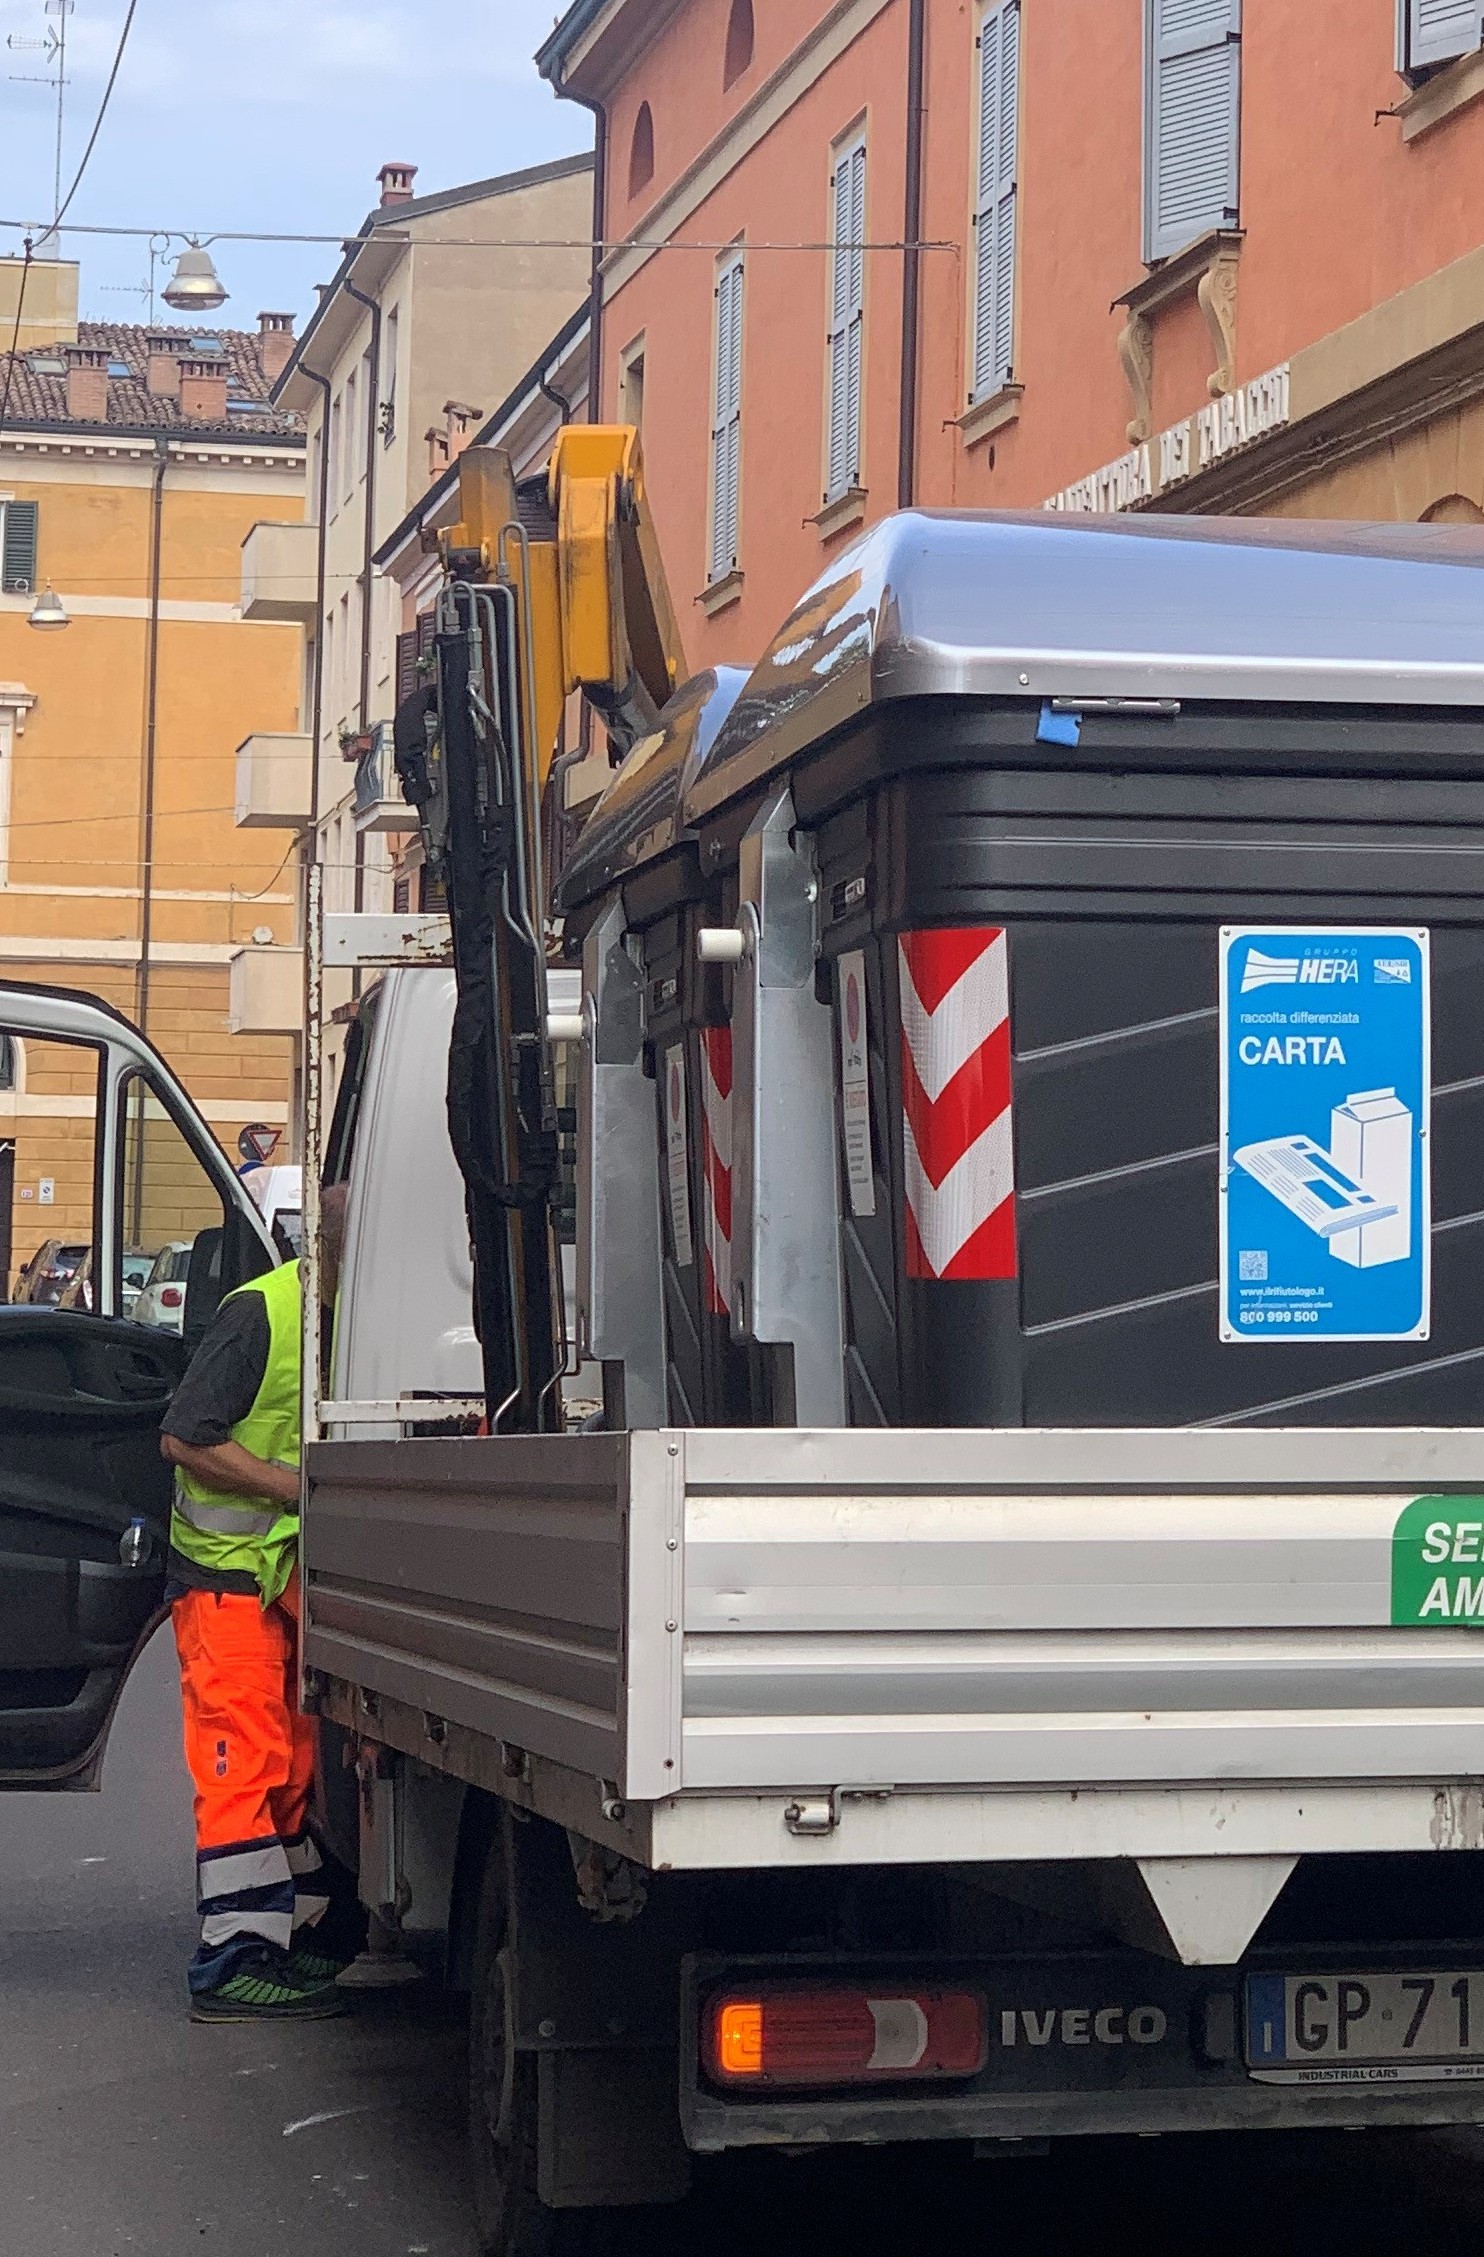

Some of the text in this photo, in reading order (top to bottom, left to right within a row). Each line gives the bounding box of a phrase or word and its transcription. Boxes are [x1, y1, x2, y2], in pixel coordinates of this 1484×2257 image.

[1304, 948, 1358, 956] GRUPPO
[1299, 959, 1359, 984] HERA
[1240, 1011, 1360, 1024] raccolta differenziata
[1238, 1036, 1347, 1065] CARTA
[1240, 1311, 1319, 1322] 800 999 500
[1422, 1522, 1484, 1563] SE
[1002, 2006, 1167, 2046] IVECO
[1295, 1981, 1371, 2052] GP
[1298, 2070, 1367, 2081] INDUSTRIAL
[1368, 2068, 1399, 2079] CARS
